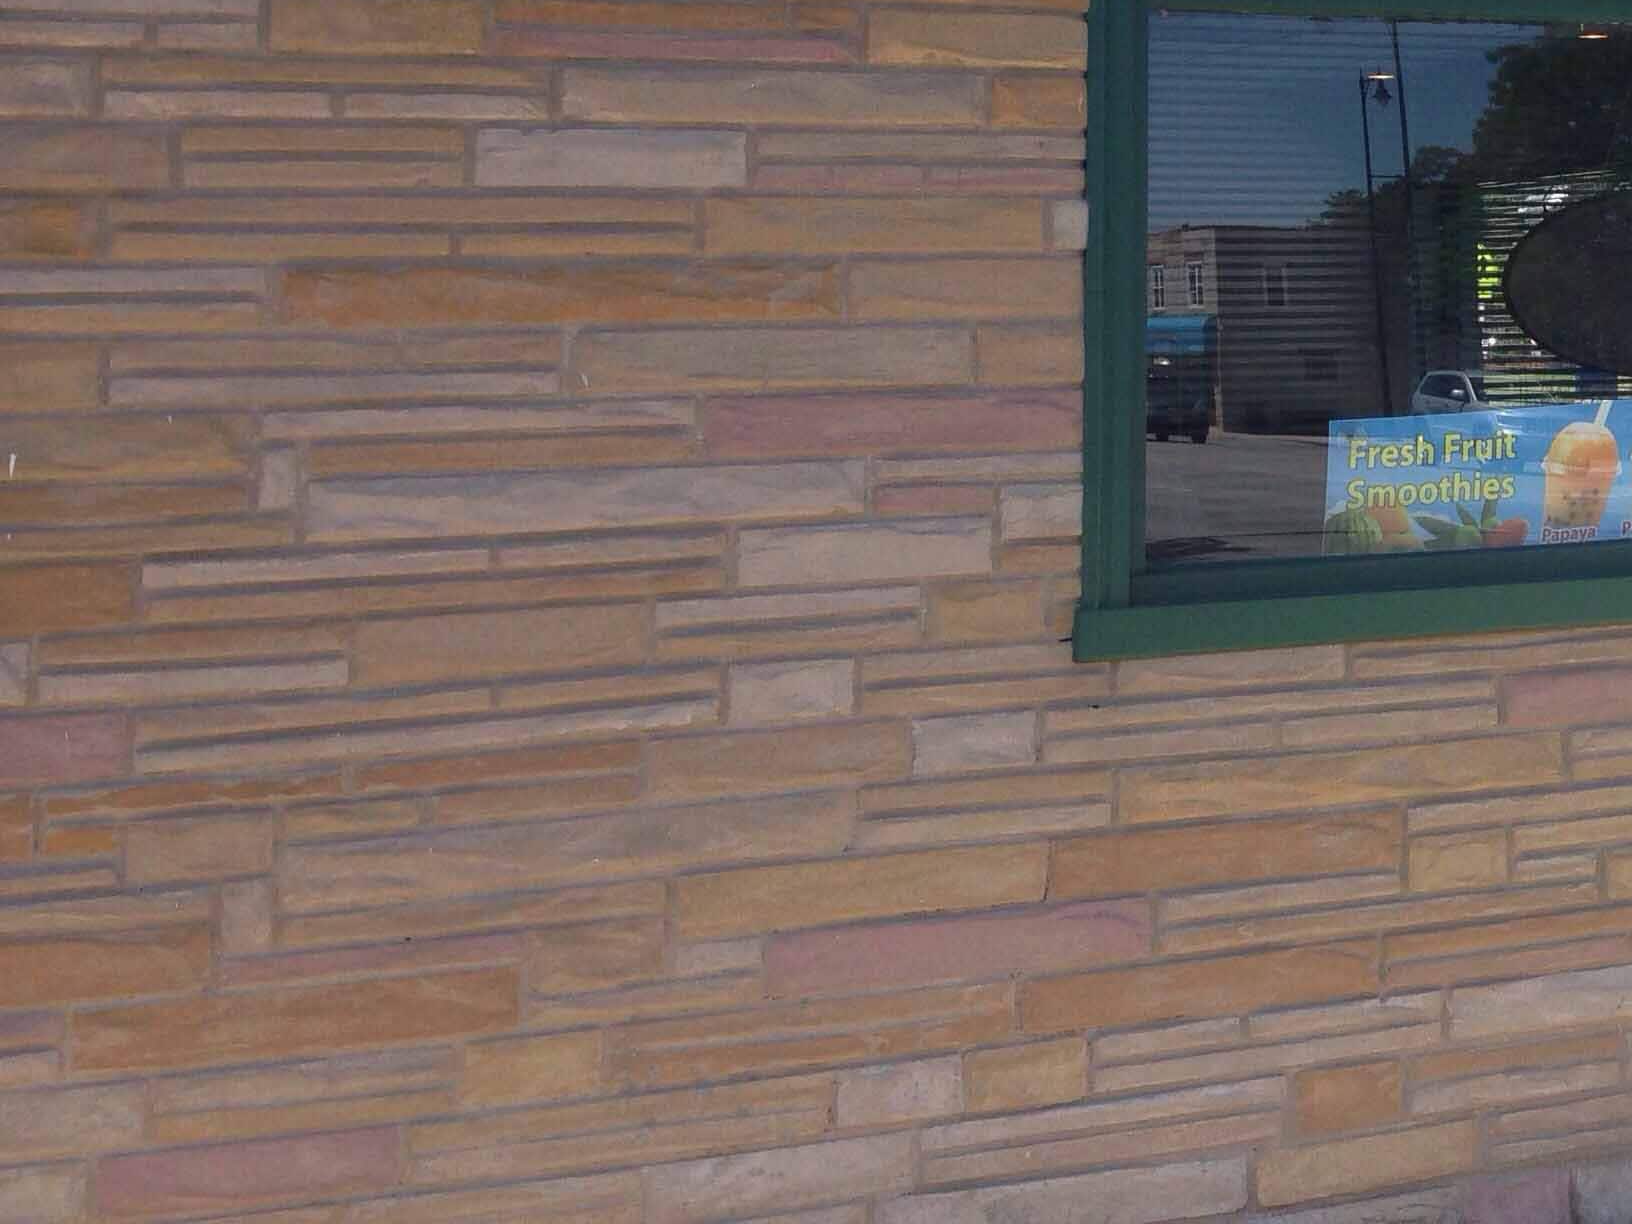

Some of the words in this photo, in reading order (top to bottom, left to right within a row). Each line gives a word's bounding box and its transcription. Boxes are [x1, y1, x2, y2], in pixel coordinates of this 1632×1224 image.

[1347, 434, 1434, 470] Fresh
[1442, 431, 1516, 464] Fruit
[1346, 472, 1516, 510] Smoothies
[1541, 526, 1597, 544] Papaya
